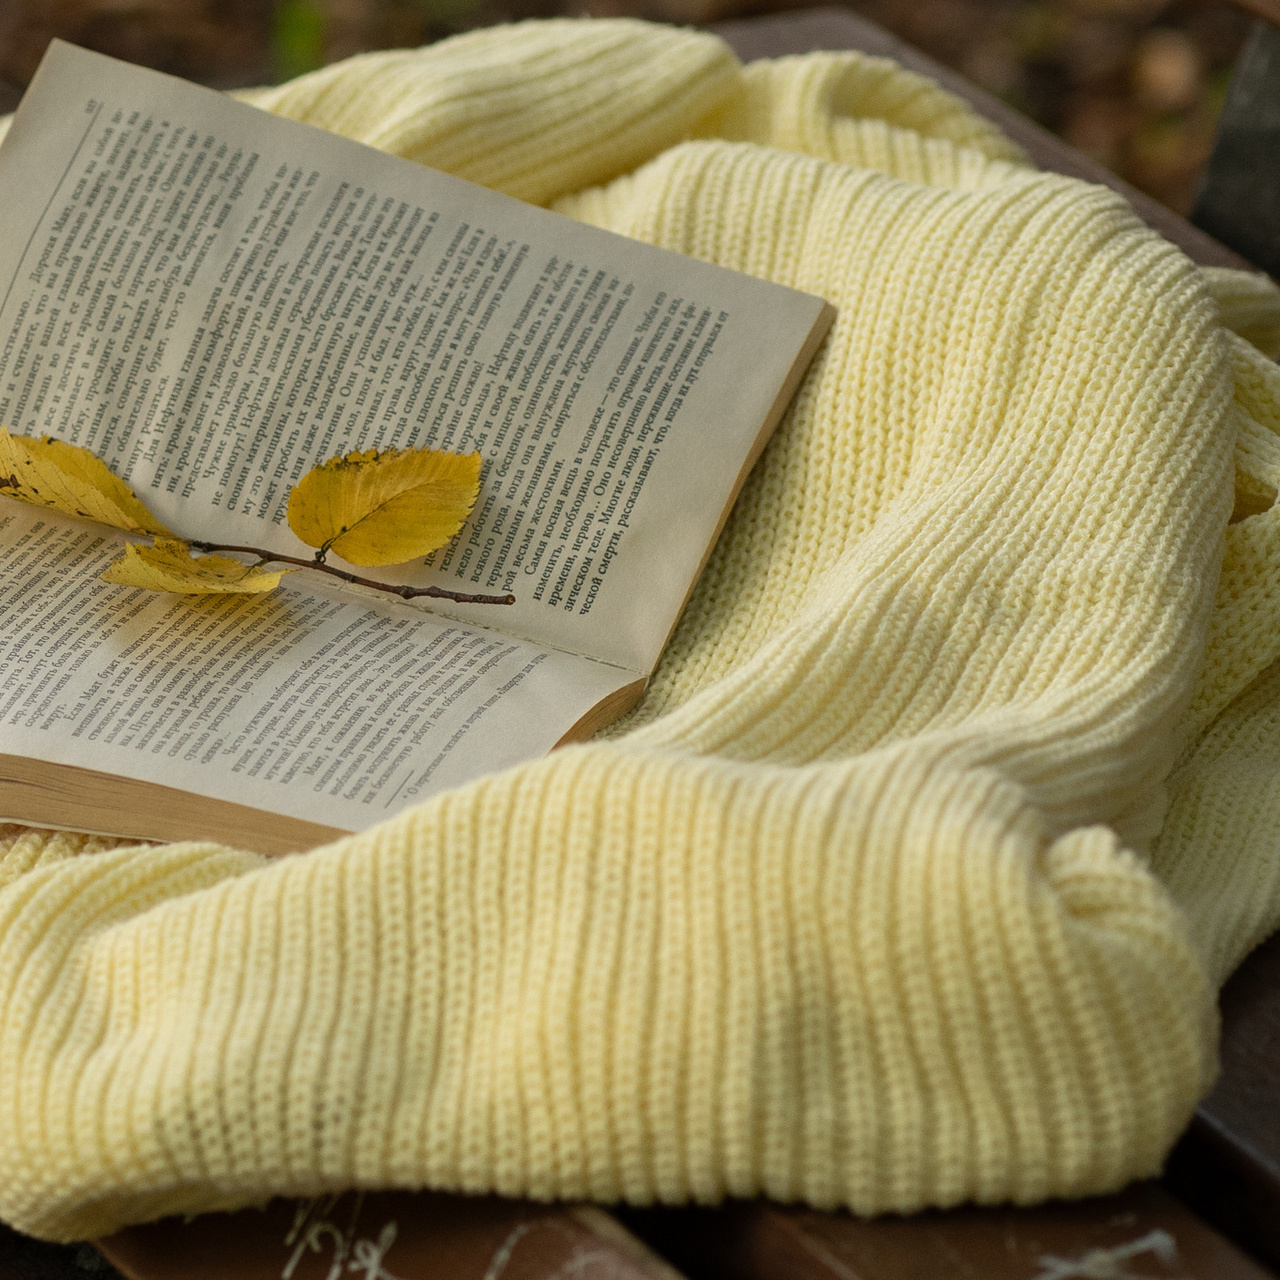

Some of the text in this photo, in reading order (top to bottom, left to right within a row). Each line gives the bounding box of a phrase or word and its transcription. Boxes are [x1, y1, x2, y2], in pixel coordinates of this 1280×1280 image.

[142, 327, 206, 463] Для Нефтиды главная
[150, 301, 235, 489] нять: кроме личного комфорта,
[166, 305, 251, 493] ни, кроме денег и удовольствий,
[180, 419, 220, 498] представляет
[214, 371, 239, 417] гораздо
[232, 311, 263, 368] большую
[202, 335, 271, 479] Чужие примеры, умные
[226, 333, 305, 511] своими материалистическими
[256, 321, 345, 519] может пробить их прагматичную
[339, 299, 392, 398] Они успокаивают
[342, 377, 374, 437] мол, плох
[380, 363, 398, 385] тот,
[391, 340, 406, 360] кто
[382, 385, 406, 422] права,
[399, 349, 420, 382] вдруг
[403, 328, 448, 414] способна задать
[416, 352, 454, 424] плохого, как
[440, 360, 485, 451] крайне сложно!
[443, 358, 469, 402] решить
[486, 331, 520, 377] Нефтиду
[121, 375, 170, 482] начнут решаться.
[211, 376, 271, 506] не помогут! Нефтида
[241, 357, 313, 515] му это женщины, которых
[271, 332, 360, 525] друзья или даже возлюбленные,
[454, 353, 562, 579] жело работать за бесценок, одиночество,
[470, 379, 565, 583] всякого рода, когда она вынуждена
[485, 382, 582, 587] териальными желаниями, смиряться
[489, 394, 524, 457] с нищетой,
[524, 407, 605, 575] Самая косная вещь в человеке
[532, 364, 646, 601] изменить, необходимо потратить огромное
[547, 554, 578, 607] времени,
[593, 471, 612, 497] Оно
[607, 394, 648, 469] несовершенно
[501, 459, 566, 593] рой весьма жестокими.
[564, 445, 644, 612] зическом теле. Многие люди,
[579, 424, 671, 615] ческой смерти, рассказывают, что,
